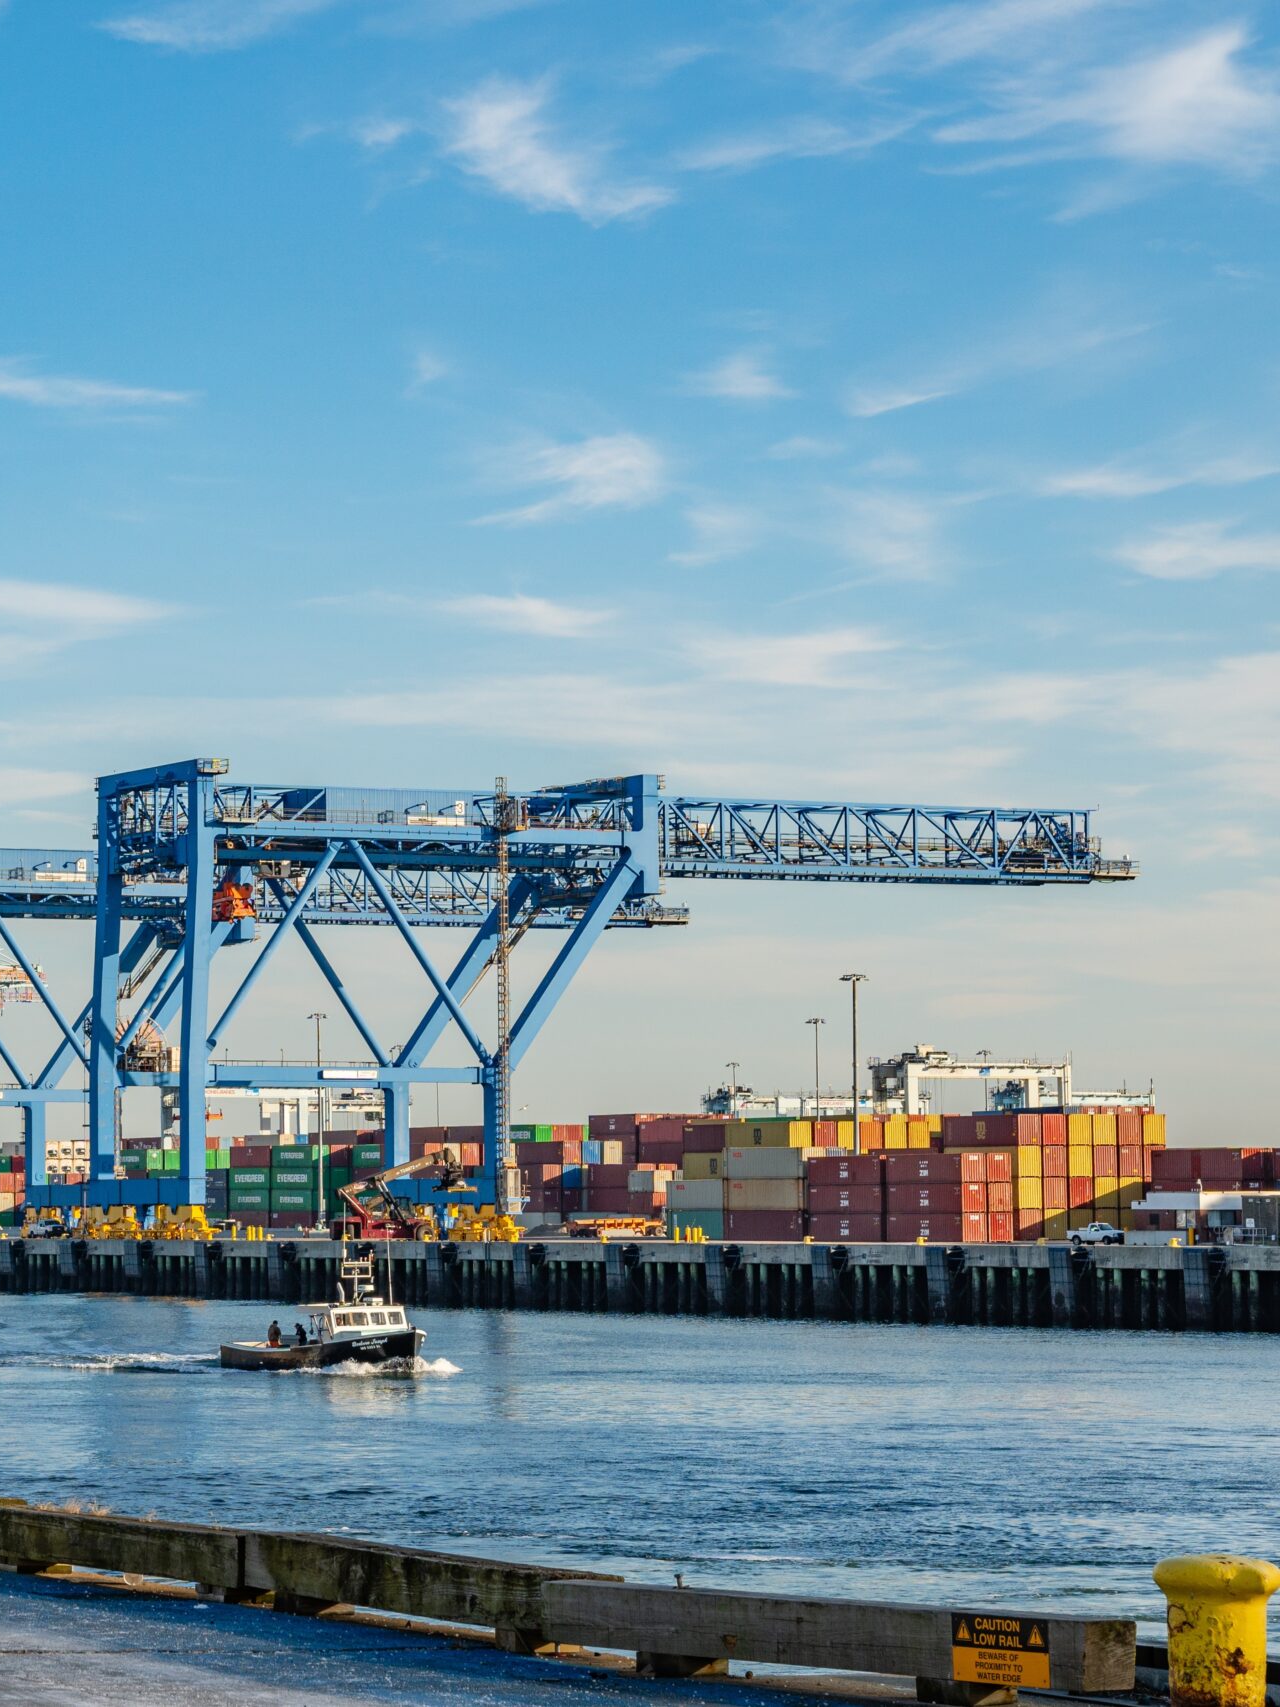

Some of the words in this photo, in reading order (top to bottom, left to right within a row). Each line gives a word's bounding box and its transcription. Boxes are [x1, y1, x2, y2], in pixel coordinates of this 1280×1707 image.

[235, 1174, 264, 1182] EVERGREEN
[277, 1174, 307, 1182] EVERGREEN
[975, 1617, 1020, 1632] CAUTION
[973, 1633, 996, 1646] LOW
[999, 1635, 1023, 1648] RAIL
[978, 1651, 1007, 1661] BEWARE
[1009, 1653, 1019, 1661] OF
[975, 1662, 1012, 1672] PROXIMITY
[1013, 1665, 1023, 1673] TO
[977, 1672, 1000, 1681] WATER
[1002, 1673, 1021, 1683] EDGE
